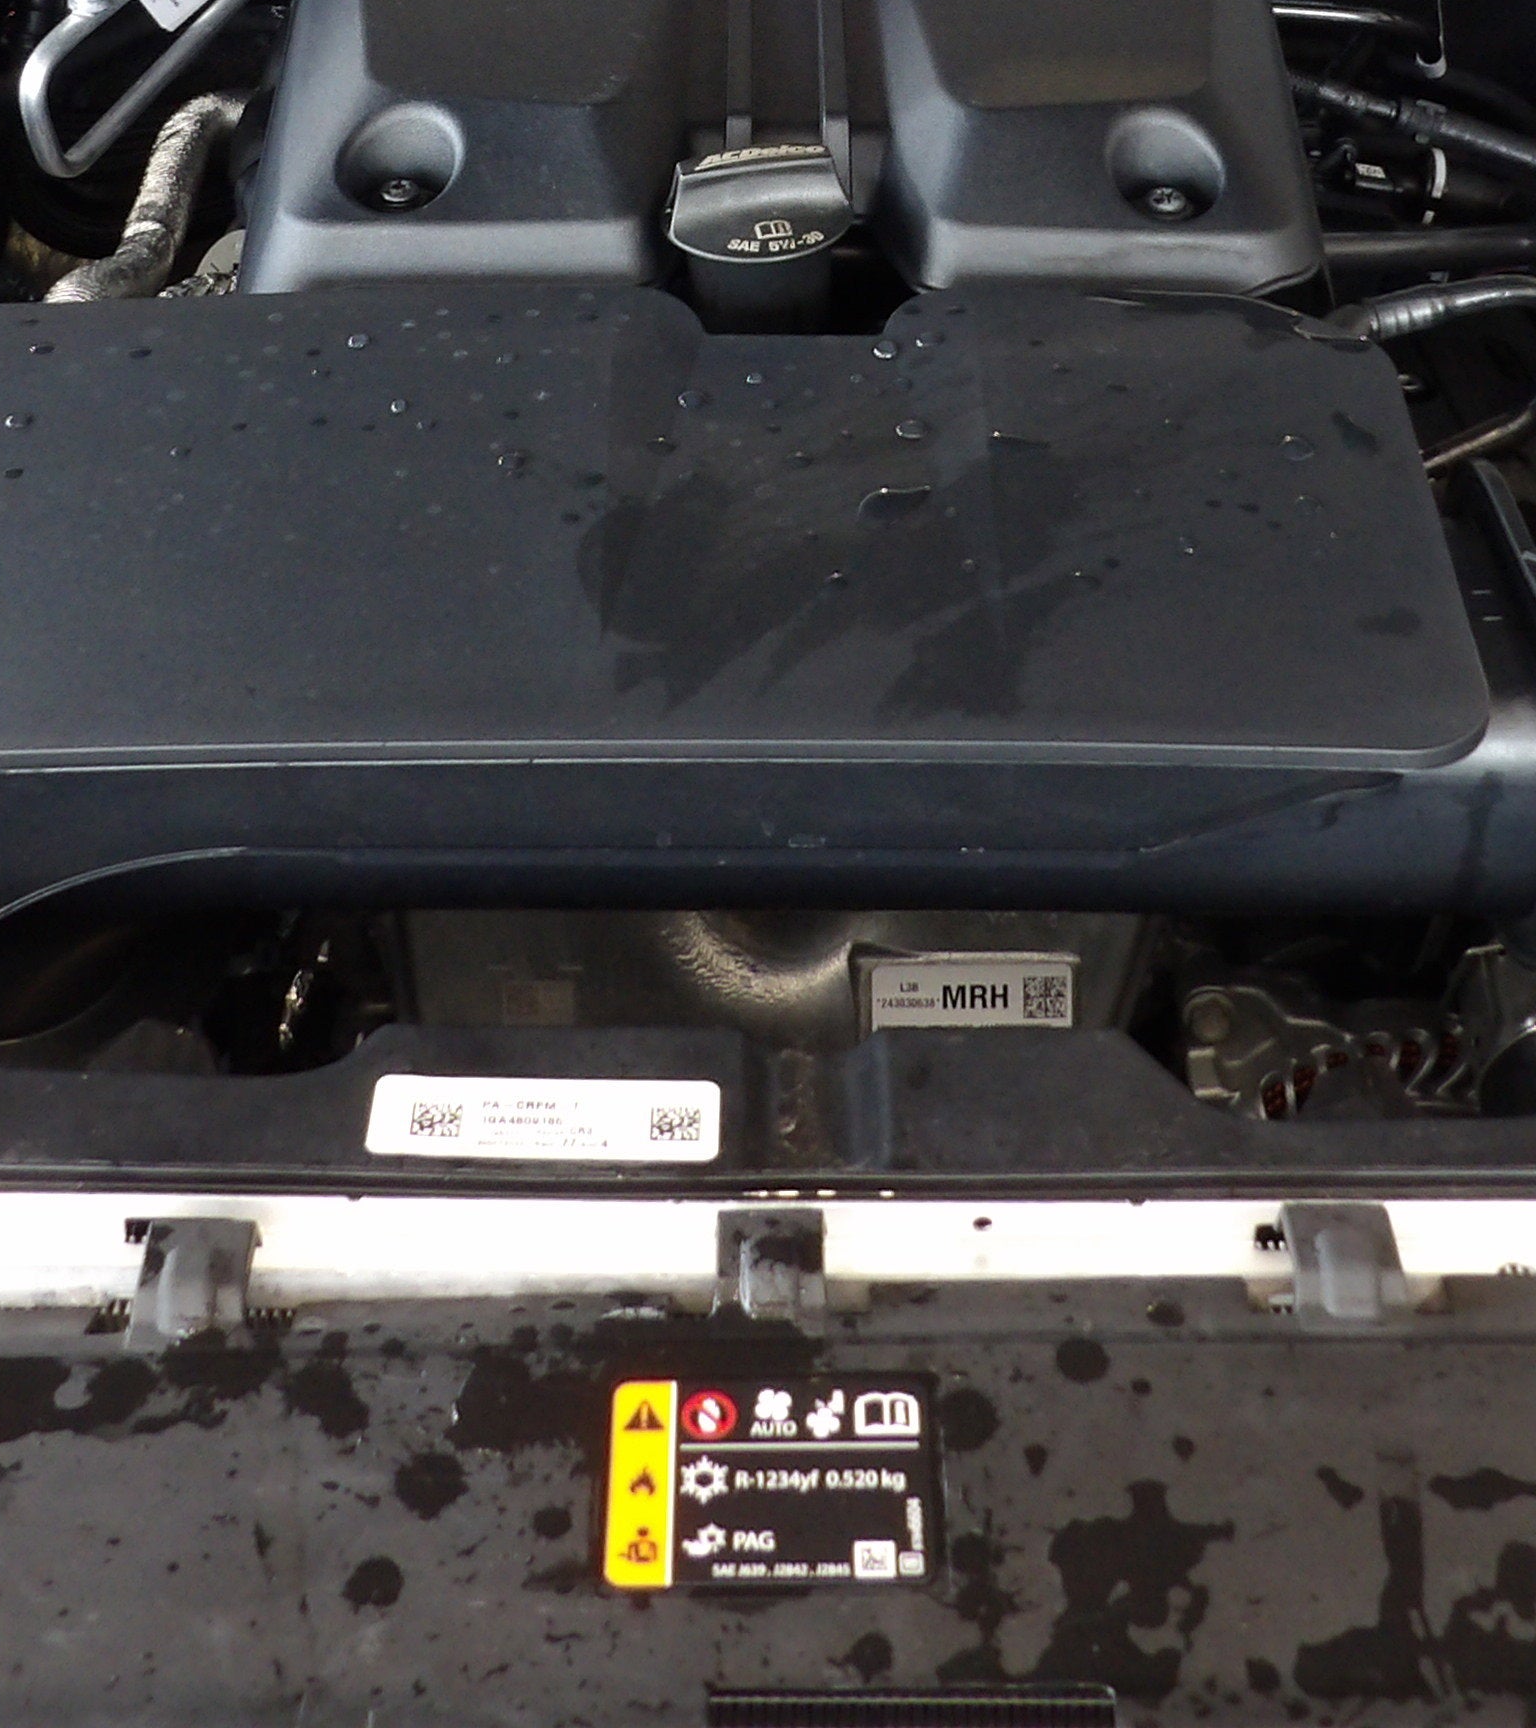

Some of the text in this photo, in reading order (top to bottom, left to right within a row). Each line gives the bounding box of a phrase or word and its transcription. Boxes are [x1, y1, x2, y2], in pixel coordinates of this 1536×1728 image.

[694, 144, 826, 171] ACDelco
[727, 238, 761, 253] SAE
[942, 983, 1009, 1010] MRH
[750, 1421, 798, 1437] AUTO
[734, 1468, 906, 1494] R-1234yf 0.520 kg
[732, 1530, 776, 1552] PAG
[712, 1562, 736, 1577] SAE
